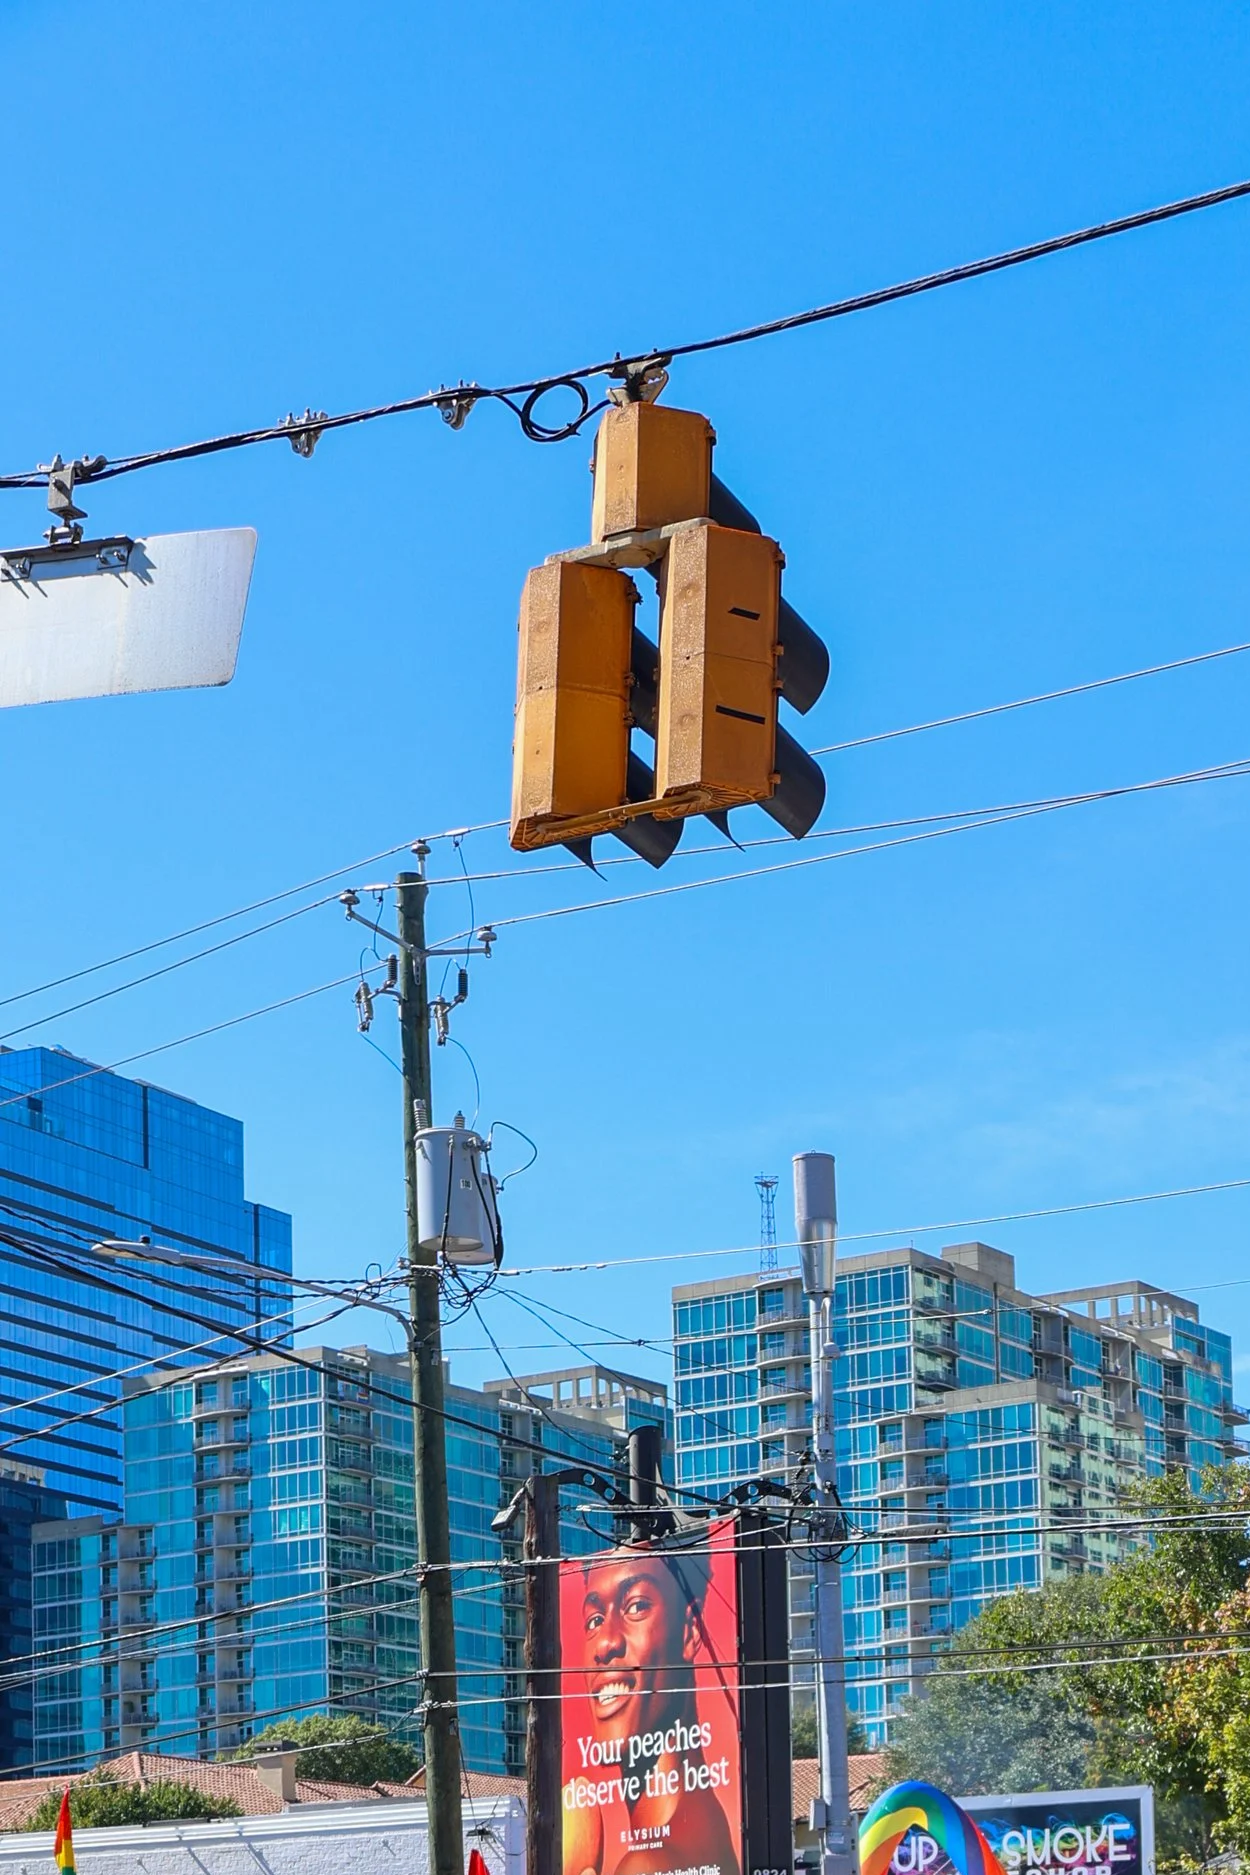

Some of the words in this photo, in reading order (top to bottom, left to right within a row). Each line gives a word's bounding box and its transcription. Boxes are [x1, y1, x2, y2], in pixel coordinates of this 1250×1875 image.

[577, 1736, 625, 1768] Your
[628, 1719, 712, 1768] peaches
[564, 1775, 640, 1810] deserve
[644, 1765, 679, 1798] the
[682, 1756, 730, 1792] best
[620, 1825, 671, 1843] ELYSIUM
[628, 1843, 649, 1852] PRIMARY
[649, 1841, 663, 1849] CARE
[893, 1835, 938, 1872] UP
[1002, 1823, 1131, 1867] SMOKE
